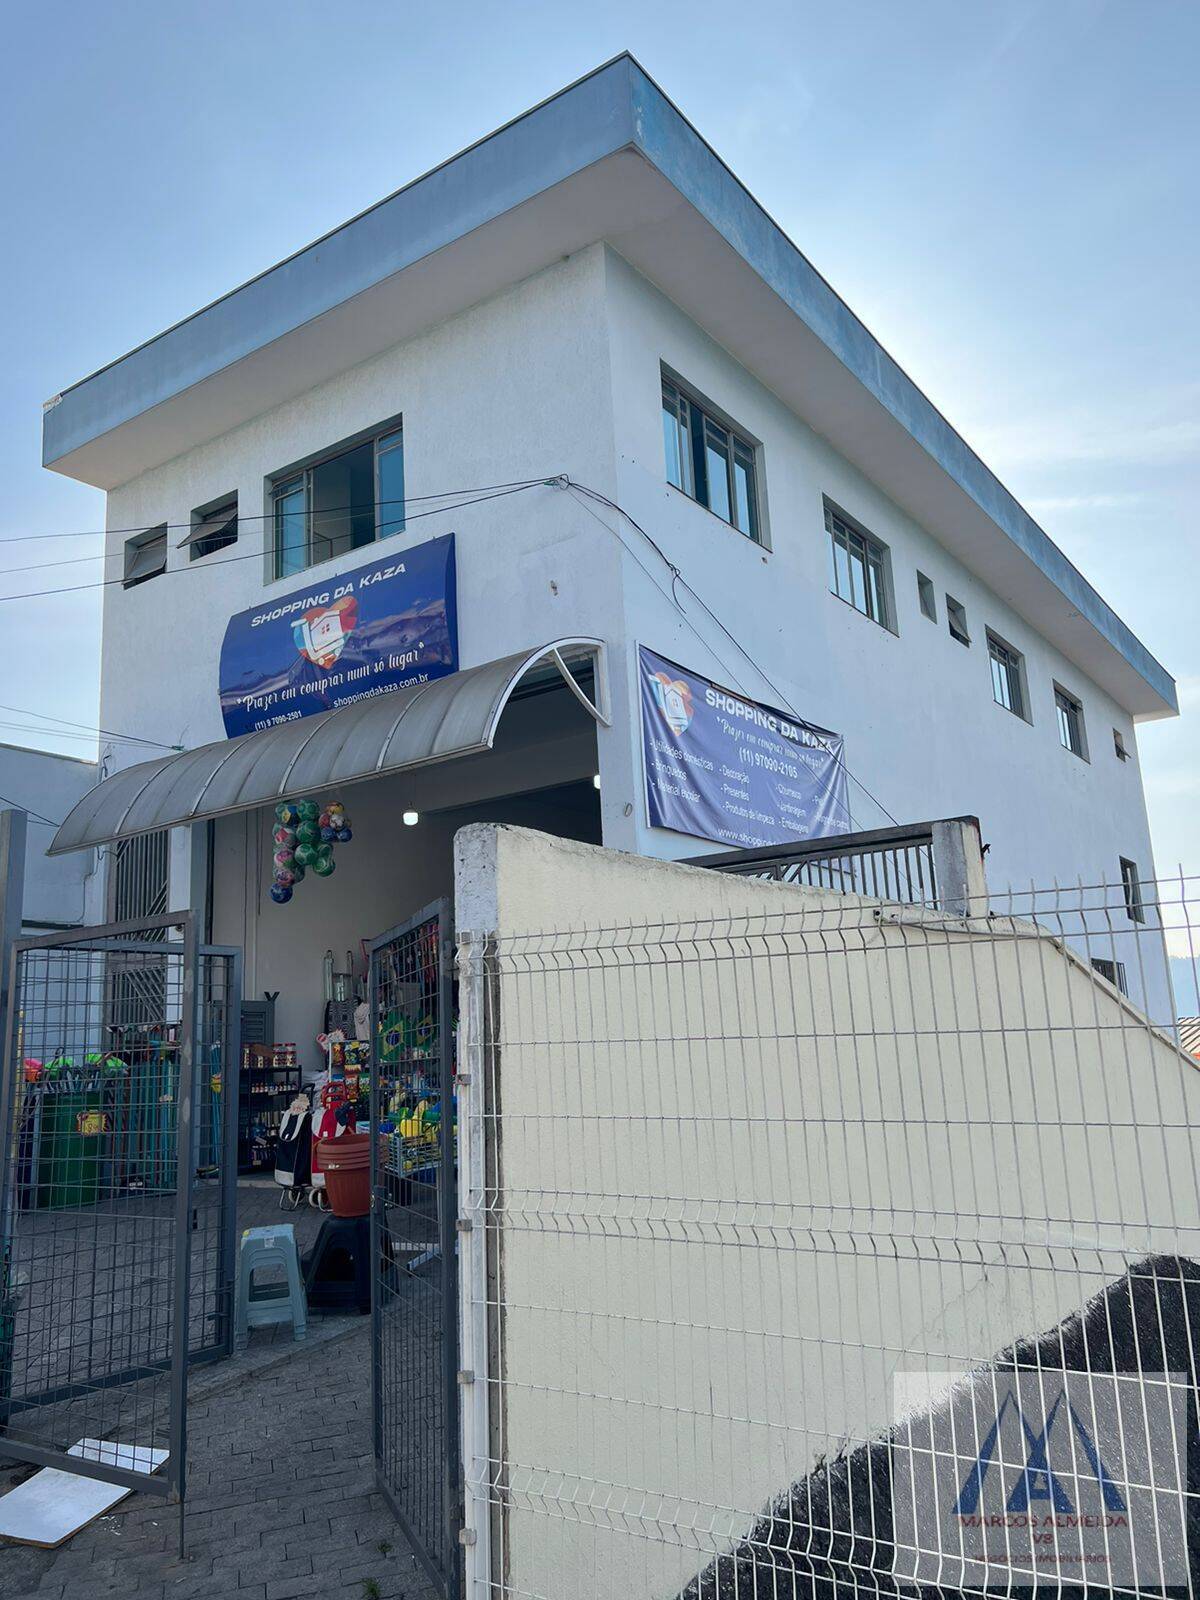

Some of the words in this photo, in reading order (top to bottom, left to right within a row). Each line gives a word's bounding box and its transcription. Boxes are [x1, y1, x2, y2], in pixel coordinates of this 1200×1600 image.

[251, 592, 330, 628] SHOPPING
[333, 582, 354, 600] DA
[359, 562, 407, 589] KAZA
[282, 686, 296, 701] em
[300, 673, 344, 702] comprar
[347, 665, 370, 684] num
[374, 656, 385, 673] só
[333, 672, 429, 708] shoppingdakaza.com.br
[254, 720, 267, 732] (11)
[704, 689, 777, 733] SHOPPING
[781, 721, 799, 741] DA
[801, 730, 834, 752] KAZA
[738, 747, 754, 767] (11)
